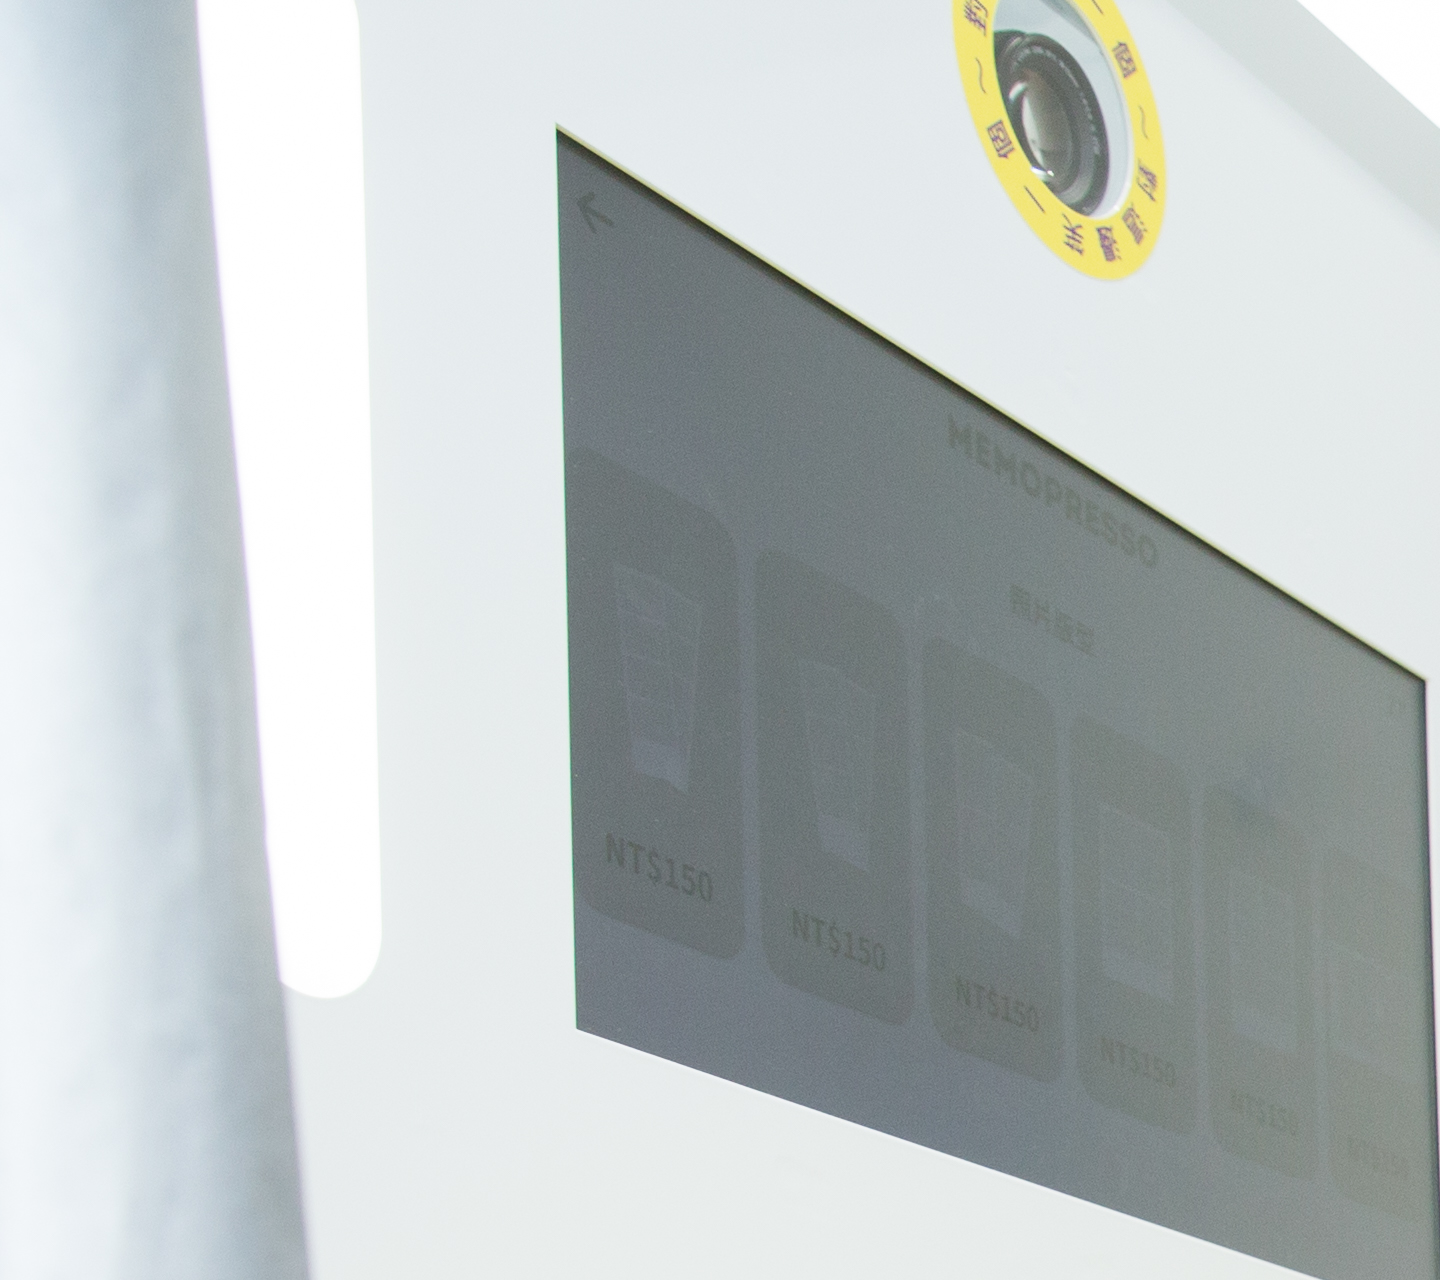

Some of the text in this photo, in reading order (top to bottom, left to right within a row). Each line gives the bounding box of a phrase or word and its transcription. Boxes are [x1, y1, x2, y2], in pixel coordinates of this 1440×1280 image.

[947, 412, 1159, 569] MEMOPRESSO
[604, 832, 715, 904] NT$150
[790, 907, 887, 973] NT$150
[954, 975, 1040, 1033] NT$150
[1100, 1036, 1176, 1089] NT$150
